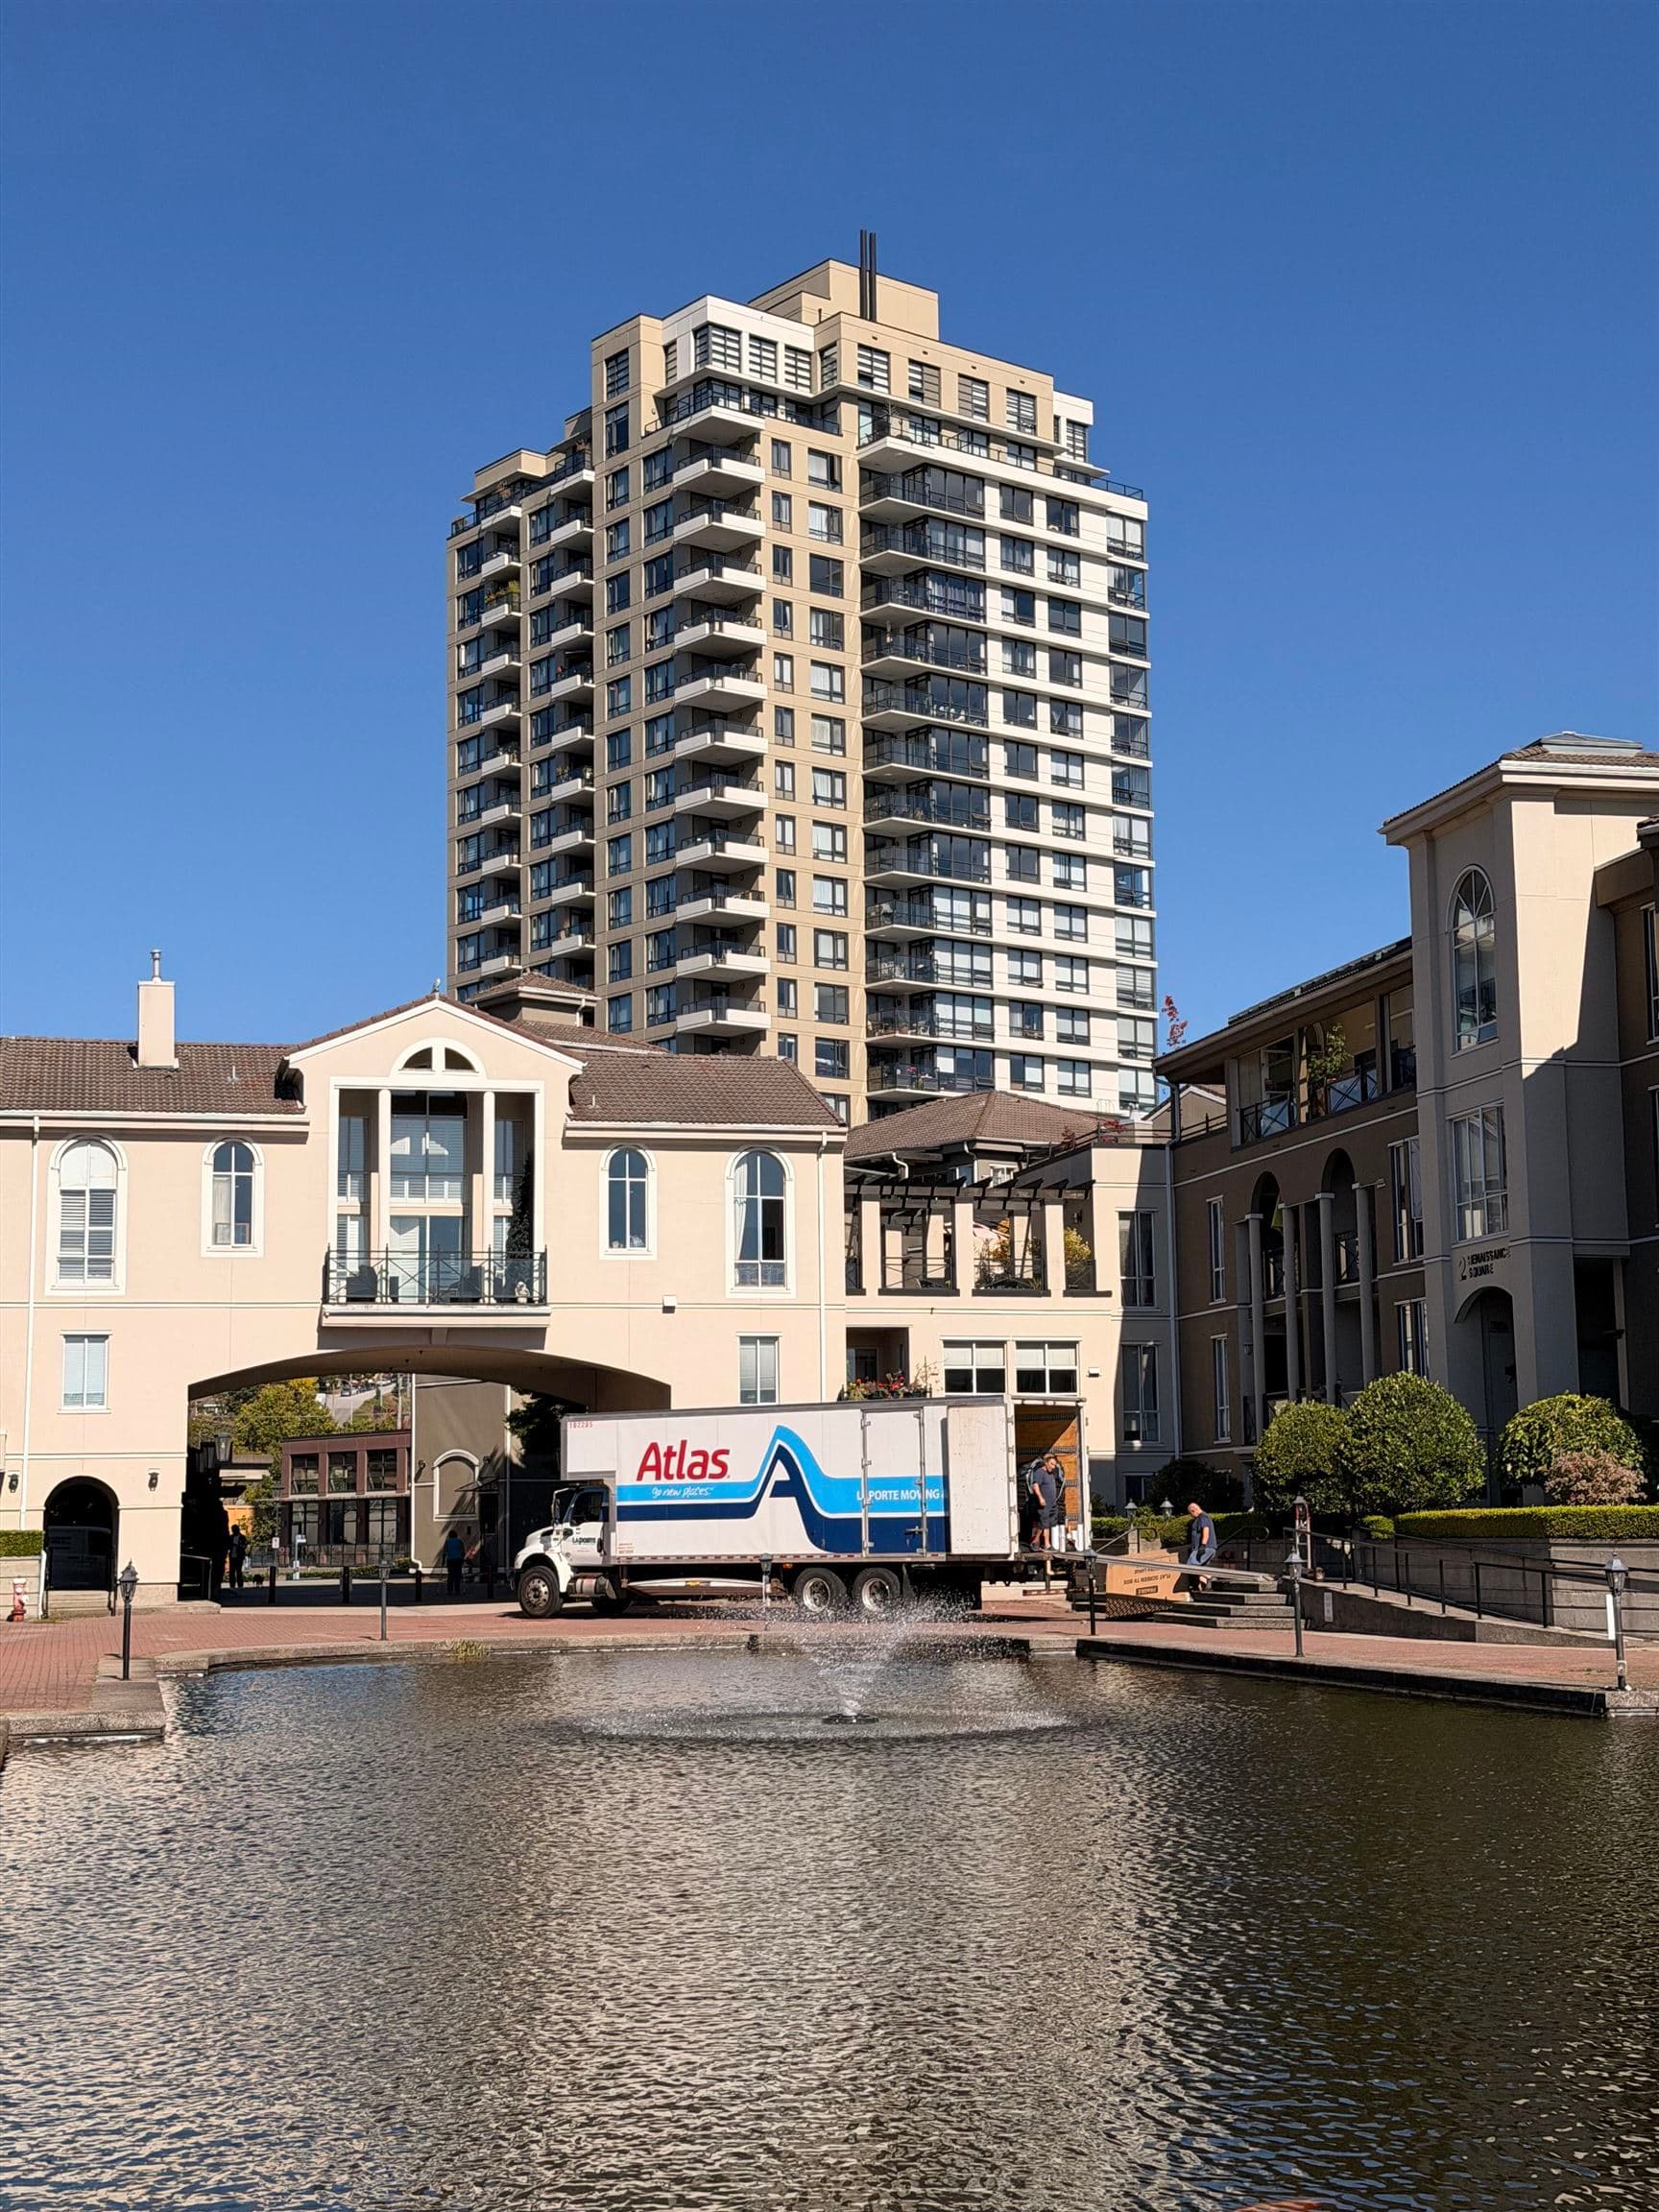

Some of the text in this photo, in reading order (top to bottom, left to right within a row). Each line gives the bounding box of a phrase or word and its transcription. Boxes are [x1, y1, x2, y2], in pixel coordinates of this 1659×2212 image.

[1458, 1255, 1467, 1282] 2
[636, 1439, 731, 1481] Atlas
[901, 1489, 941, 1500] MOVNG
